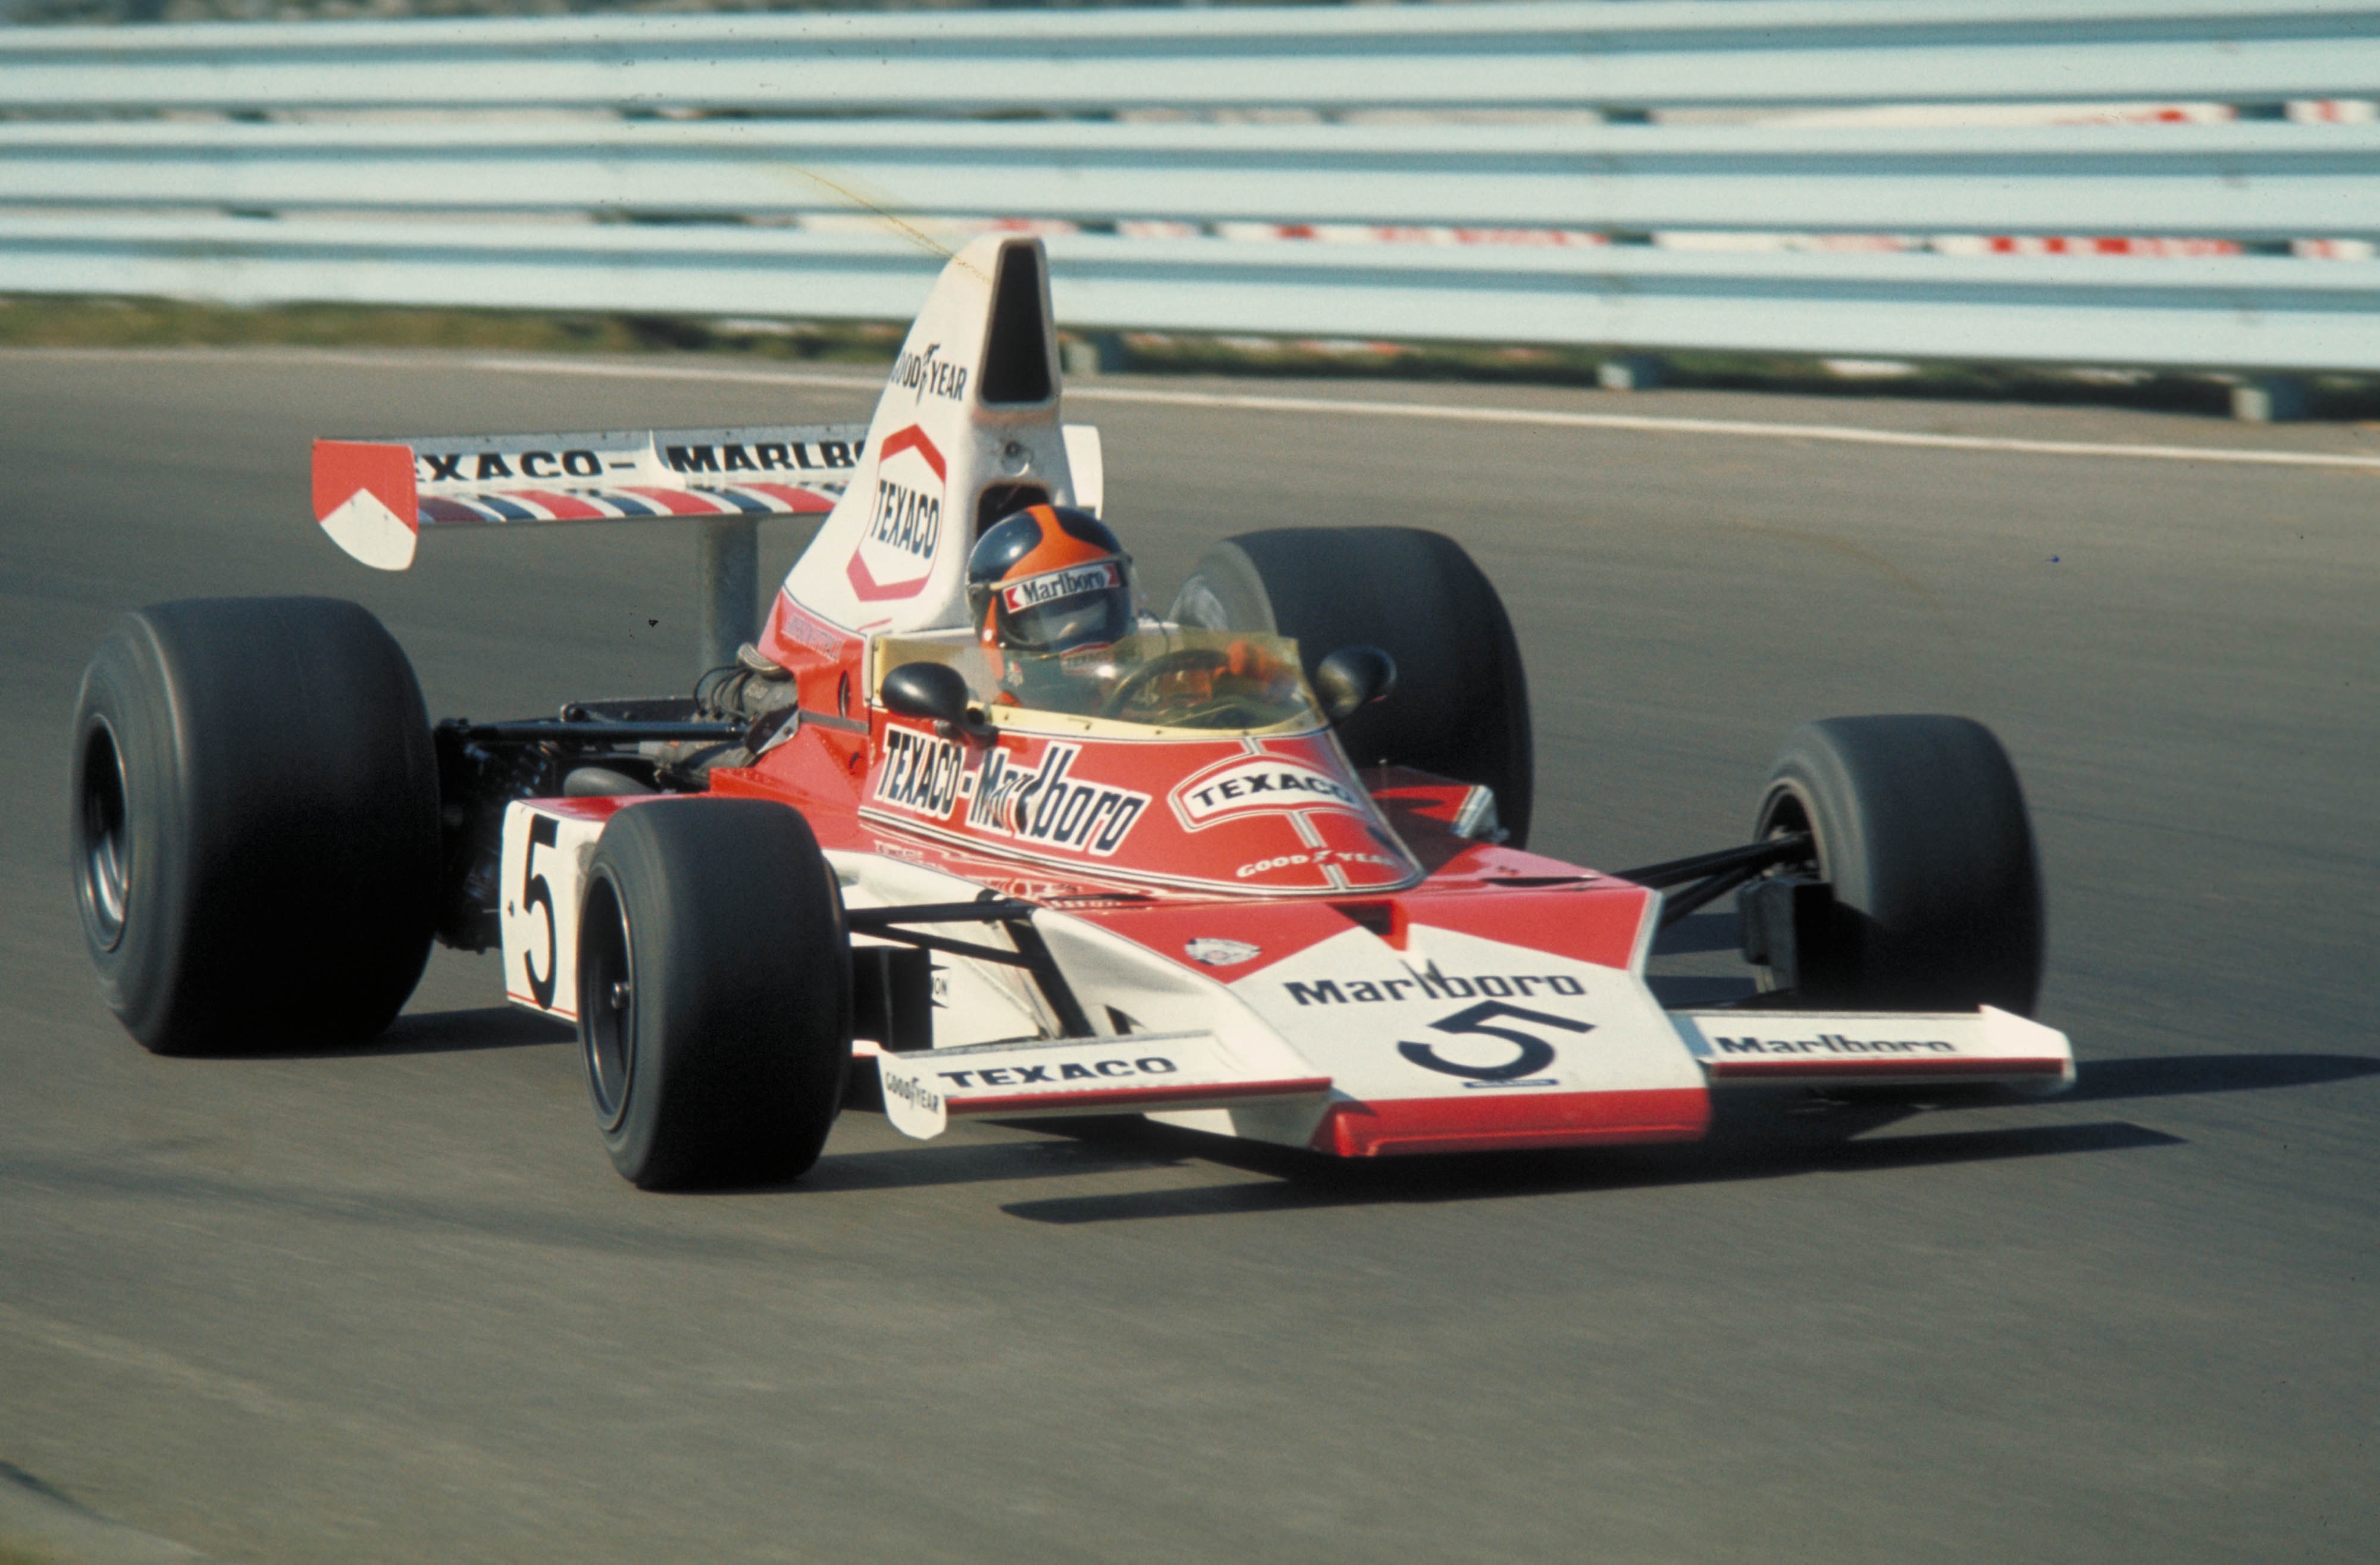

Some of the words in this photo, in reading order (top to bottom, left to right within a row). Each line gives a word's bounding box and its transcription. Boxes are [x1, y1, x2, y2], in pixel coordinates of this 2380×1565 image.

[870, 480, 940, 558] TEXACO
[1023, 570, 1105, 605] Marlboro
[1192, 773, 1356, 806] TEXACO
[523, 813, 559, 1010] 5
[1283, 959, 1586, 1006] Marlboro
[1398, 1000, 1597, 1081] 5
[1715, 1034, 1956, 1053] Marlboro
[937, 1057, 1177, 1087] TEXACO
